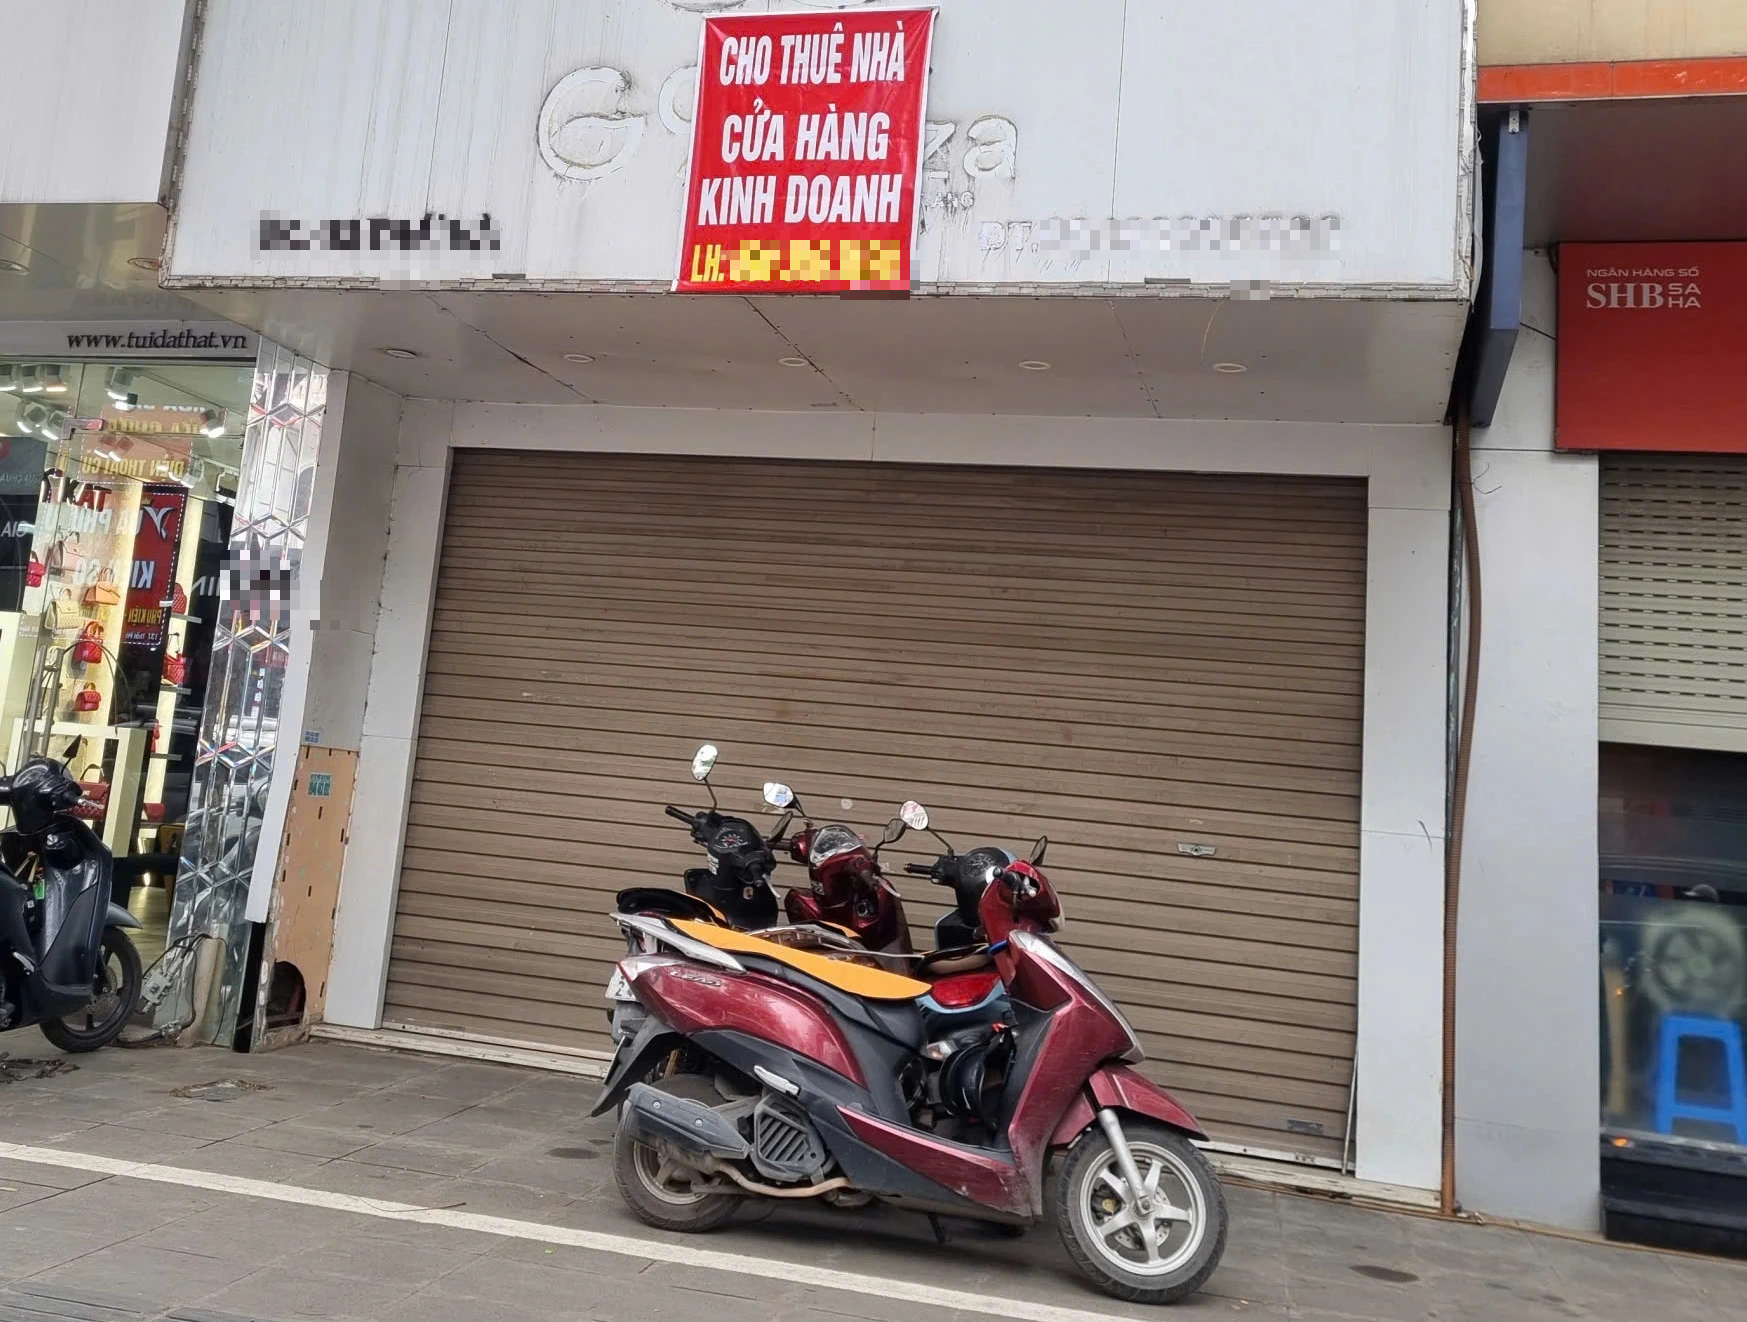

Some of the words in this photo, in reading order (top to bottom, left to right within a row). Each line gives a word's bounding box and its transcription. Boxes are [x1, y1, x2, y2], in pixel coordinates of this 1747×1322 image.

[719, 36, 771, 86] CHO
[780, 24, 846, 84] THUÊ
[850, 20, 907, 83] NHÀ
[721, 98, 785, 164] CỬA
[795, 103, 890, 162] HÀNG
[698, 175, 776, 226] KINH
[784, 174, 903, 224] DOANH
[1586, 267, 1629, 277] NGÂN
[1633, 266, 1675, 277] HÀNG
[1678, 265, 1700, 277] SỐ
[1586, 282, 1665, 309] SHB
[1668, 282, 1702, 295] SA
[1668, 296, 1702, 309] HA
[67, 329, 248, 350] www.tuidathat.vn
